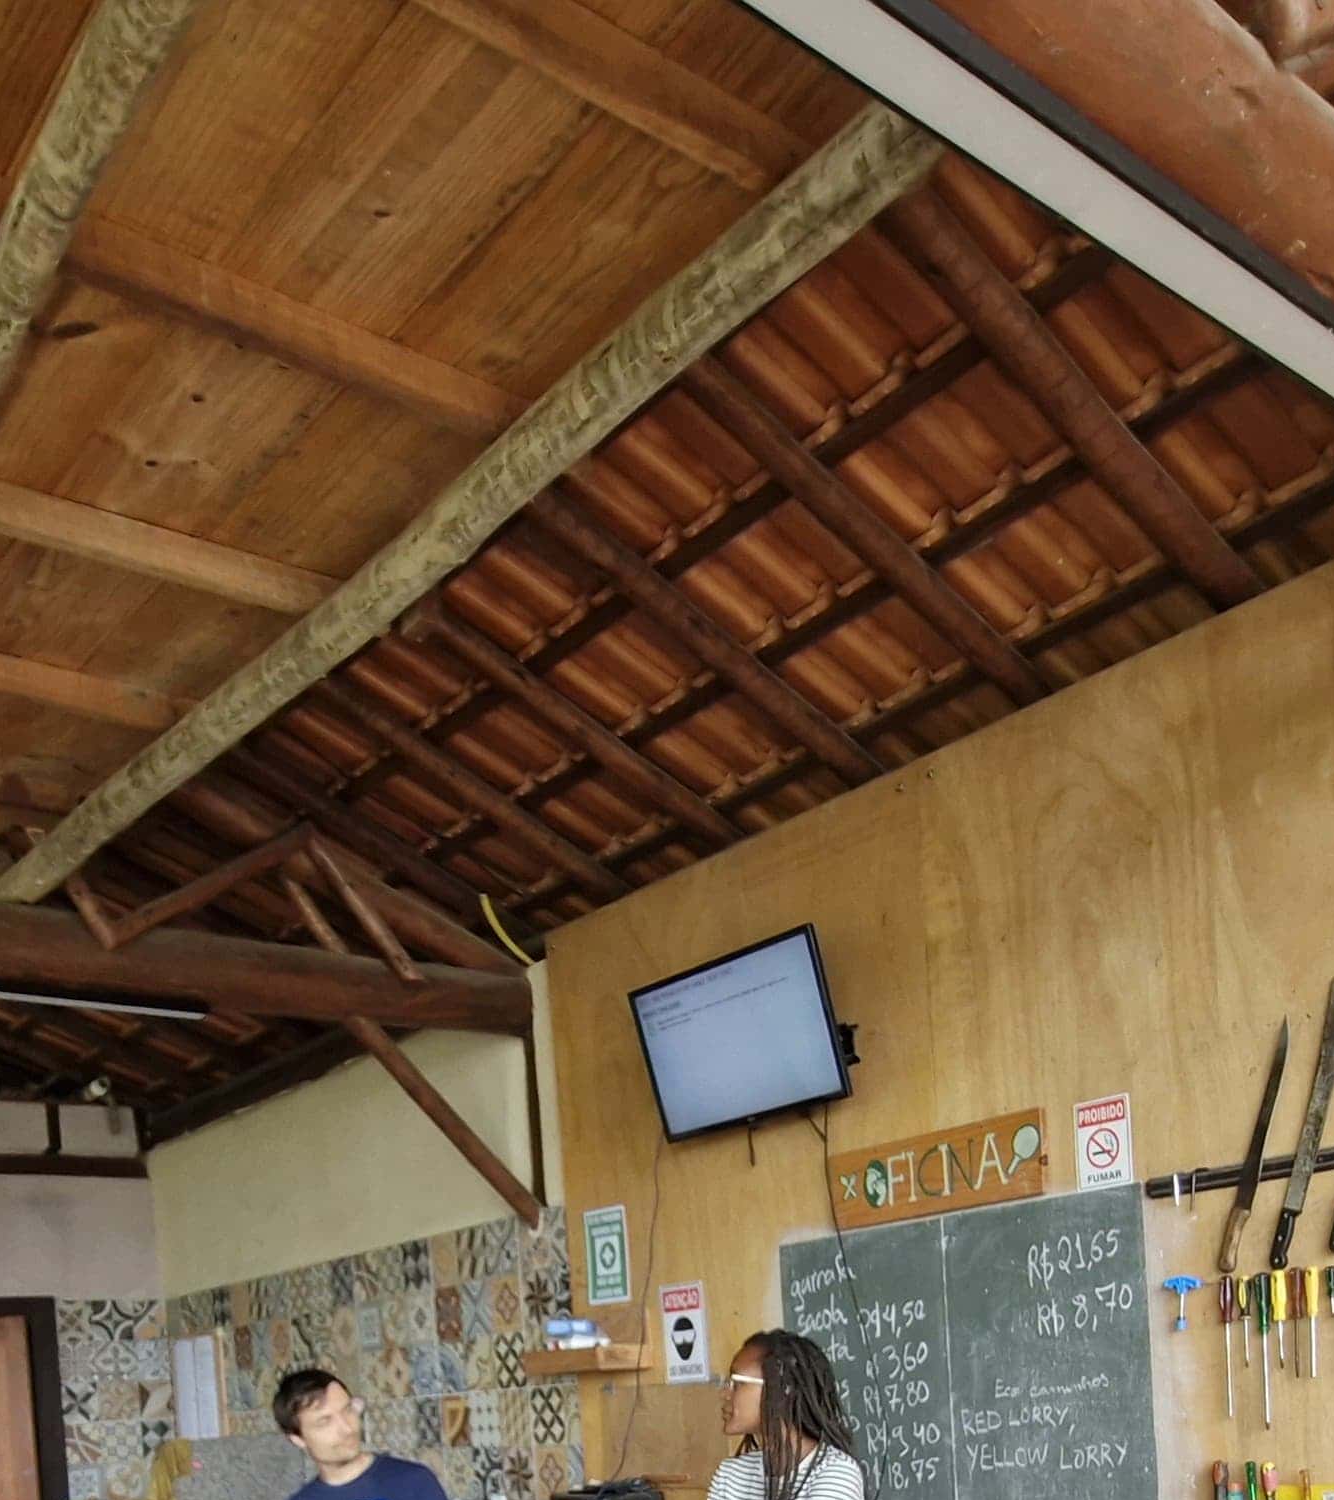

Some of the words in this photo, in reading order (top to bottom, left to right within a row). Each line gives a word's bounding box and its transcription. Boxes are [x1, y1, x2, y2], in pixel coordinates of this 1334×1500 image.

[1078, 1101, 1125, 1126] PROIBIDO
[1087, 1169, 1123, 1184] FUMAR
[960, 1408, 1002, 1436] RED
[1008, 1405, 1076, 1437] LORRY,
[966, 1442, 1049, 1473] YELLOW
[1059, 1441, 1129, 1470] LORRY
